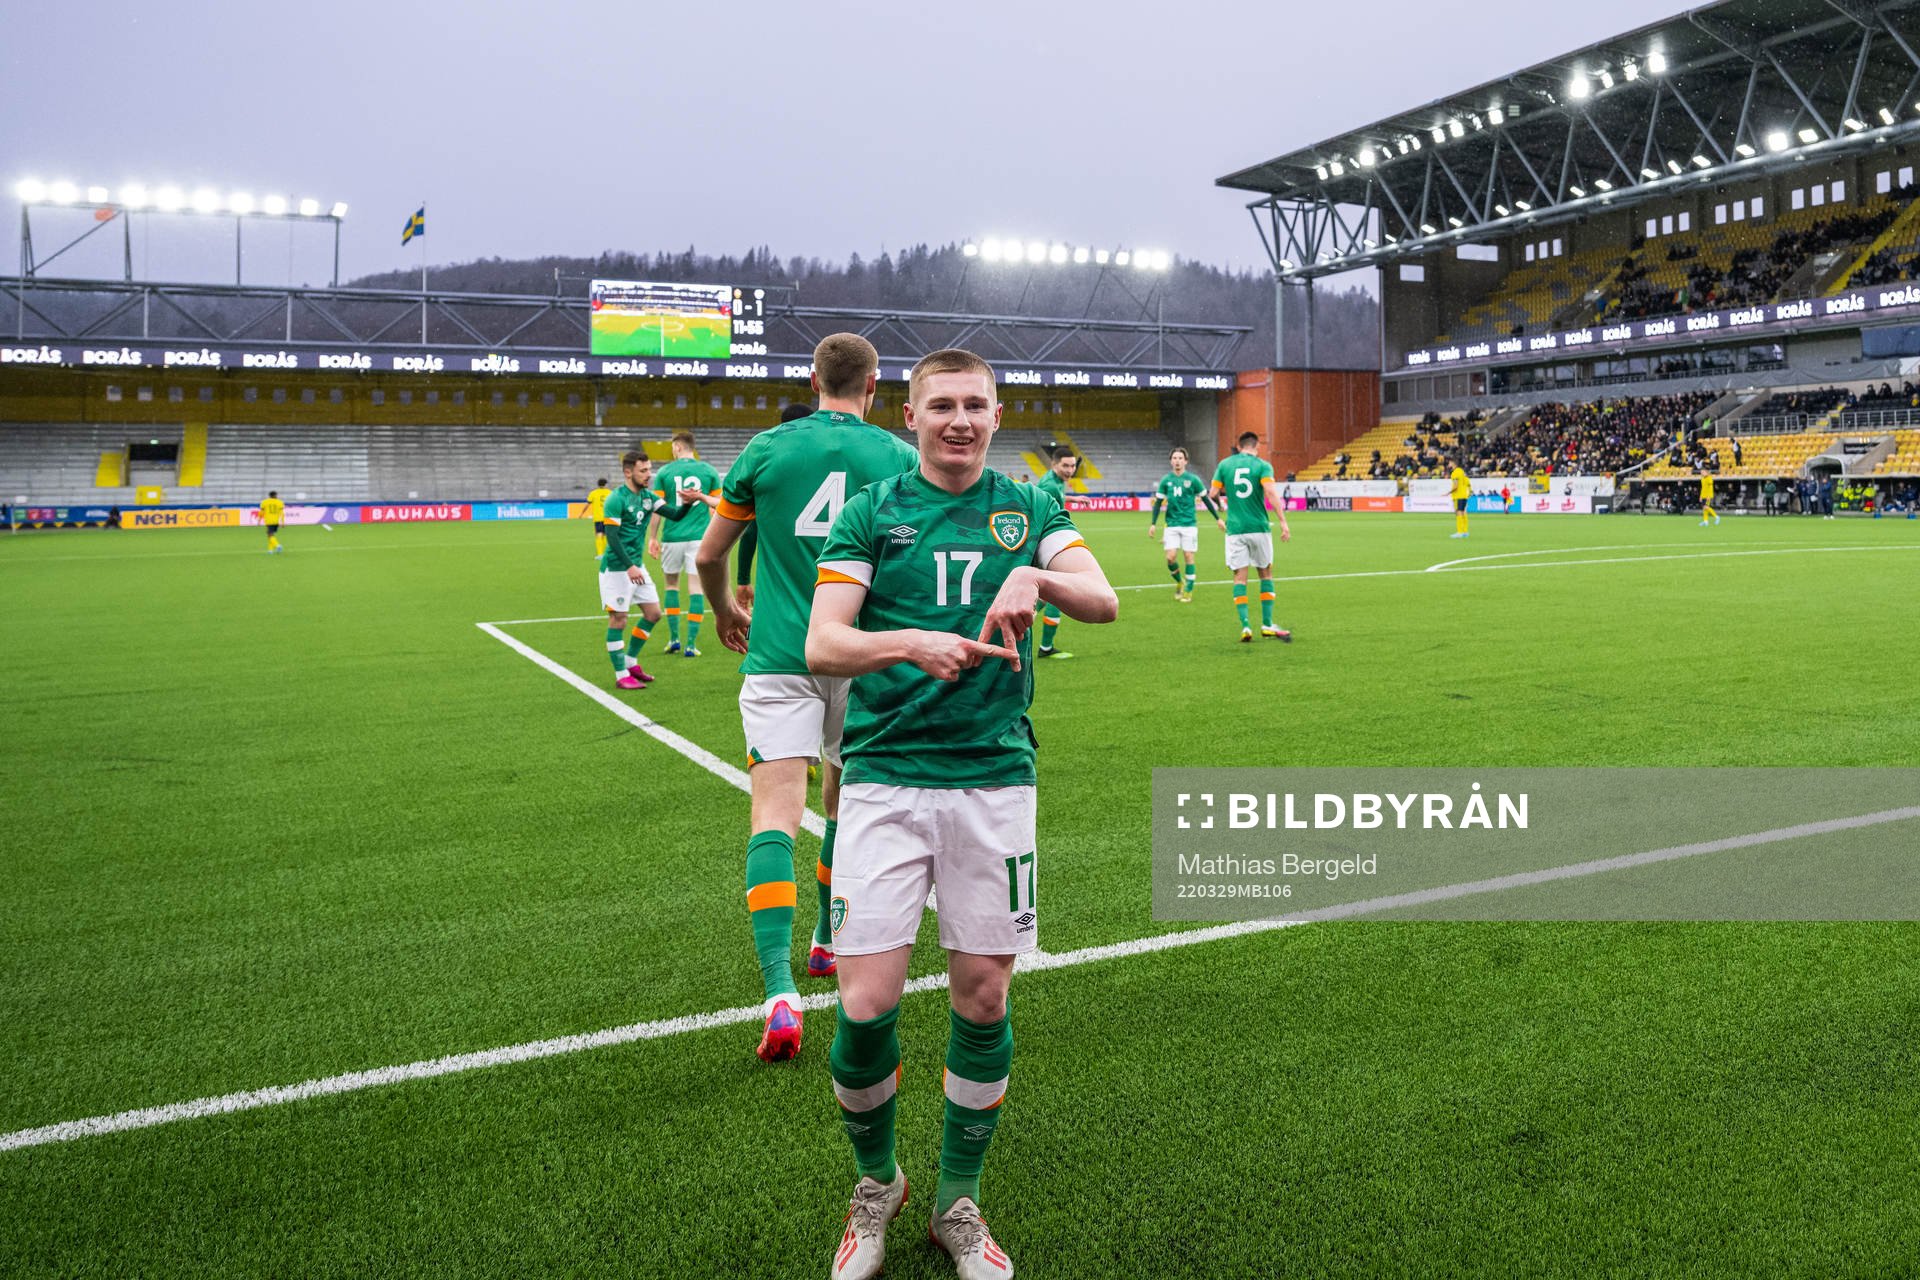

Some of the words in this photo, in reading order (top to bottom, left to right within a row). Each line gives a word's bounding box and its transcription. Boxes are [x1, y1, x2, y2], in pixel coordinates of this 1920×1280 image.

[733, 299, 743, 316] 0
[755, 299, 763, 317] 1
[1602, 325, 1632, 341] BORÅS
[1645, 318, 1675, 336] BORÅS
[1687, 312, 1719, 331] BORÅS
[1730, 307, 1764, 326] BORÅS
[1777, 300, 1812, 320] BORÅS
[1826, 294, 1865, 313] BORÅS
[1880, 286, 1920, 307] BORÅS
[1, 345, 62, 363] BORÅS
[83, 347, 142, 365] BORÅS
[164, 348, 222, 366] BORÅS
[243, 351, 297, 368] BORÅS
[319, 352, 372, 369] BORÅS
[393, 354, 444, 371] BORÅS
[539, 358, 586, 374] BORÅS
[602, 360, 648, 375] BORÅS
[663, 361, 709, 376] BORÅS
[726, 363, 768, 378] BORÅS
[1005, 370, 1042, 384] BORÅS
[1055, 371, 1090, 385] BORÅS
[1103, 373, 1137, 387] BORÅS
[1150, 374, 1183, 387] BORÅS
[1196, 375, 1228, 389] BORÅS
[1233, 467, 1253, 499] 5
[372, 506, 463, 521] BAUHAUS
[794, 471, 847, 537] 4
[998, 516, 1021, 525] Ireland
[891, 537, 916, 545] umbro
[933, 551, 984, 606] 17
[1005, 851, 1035, 913] 17
[1016, 924, 1035, 934] umbro
